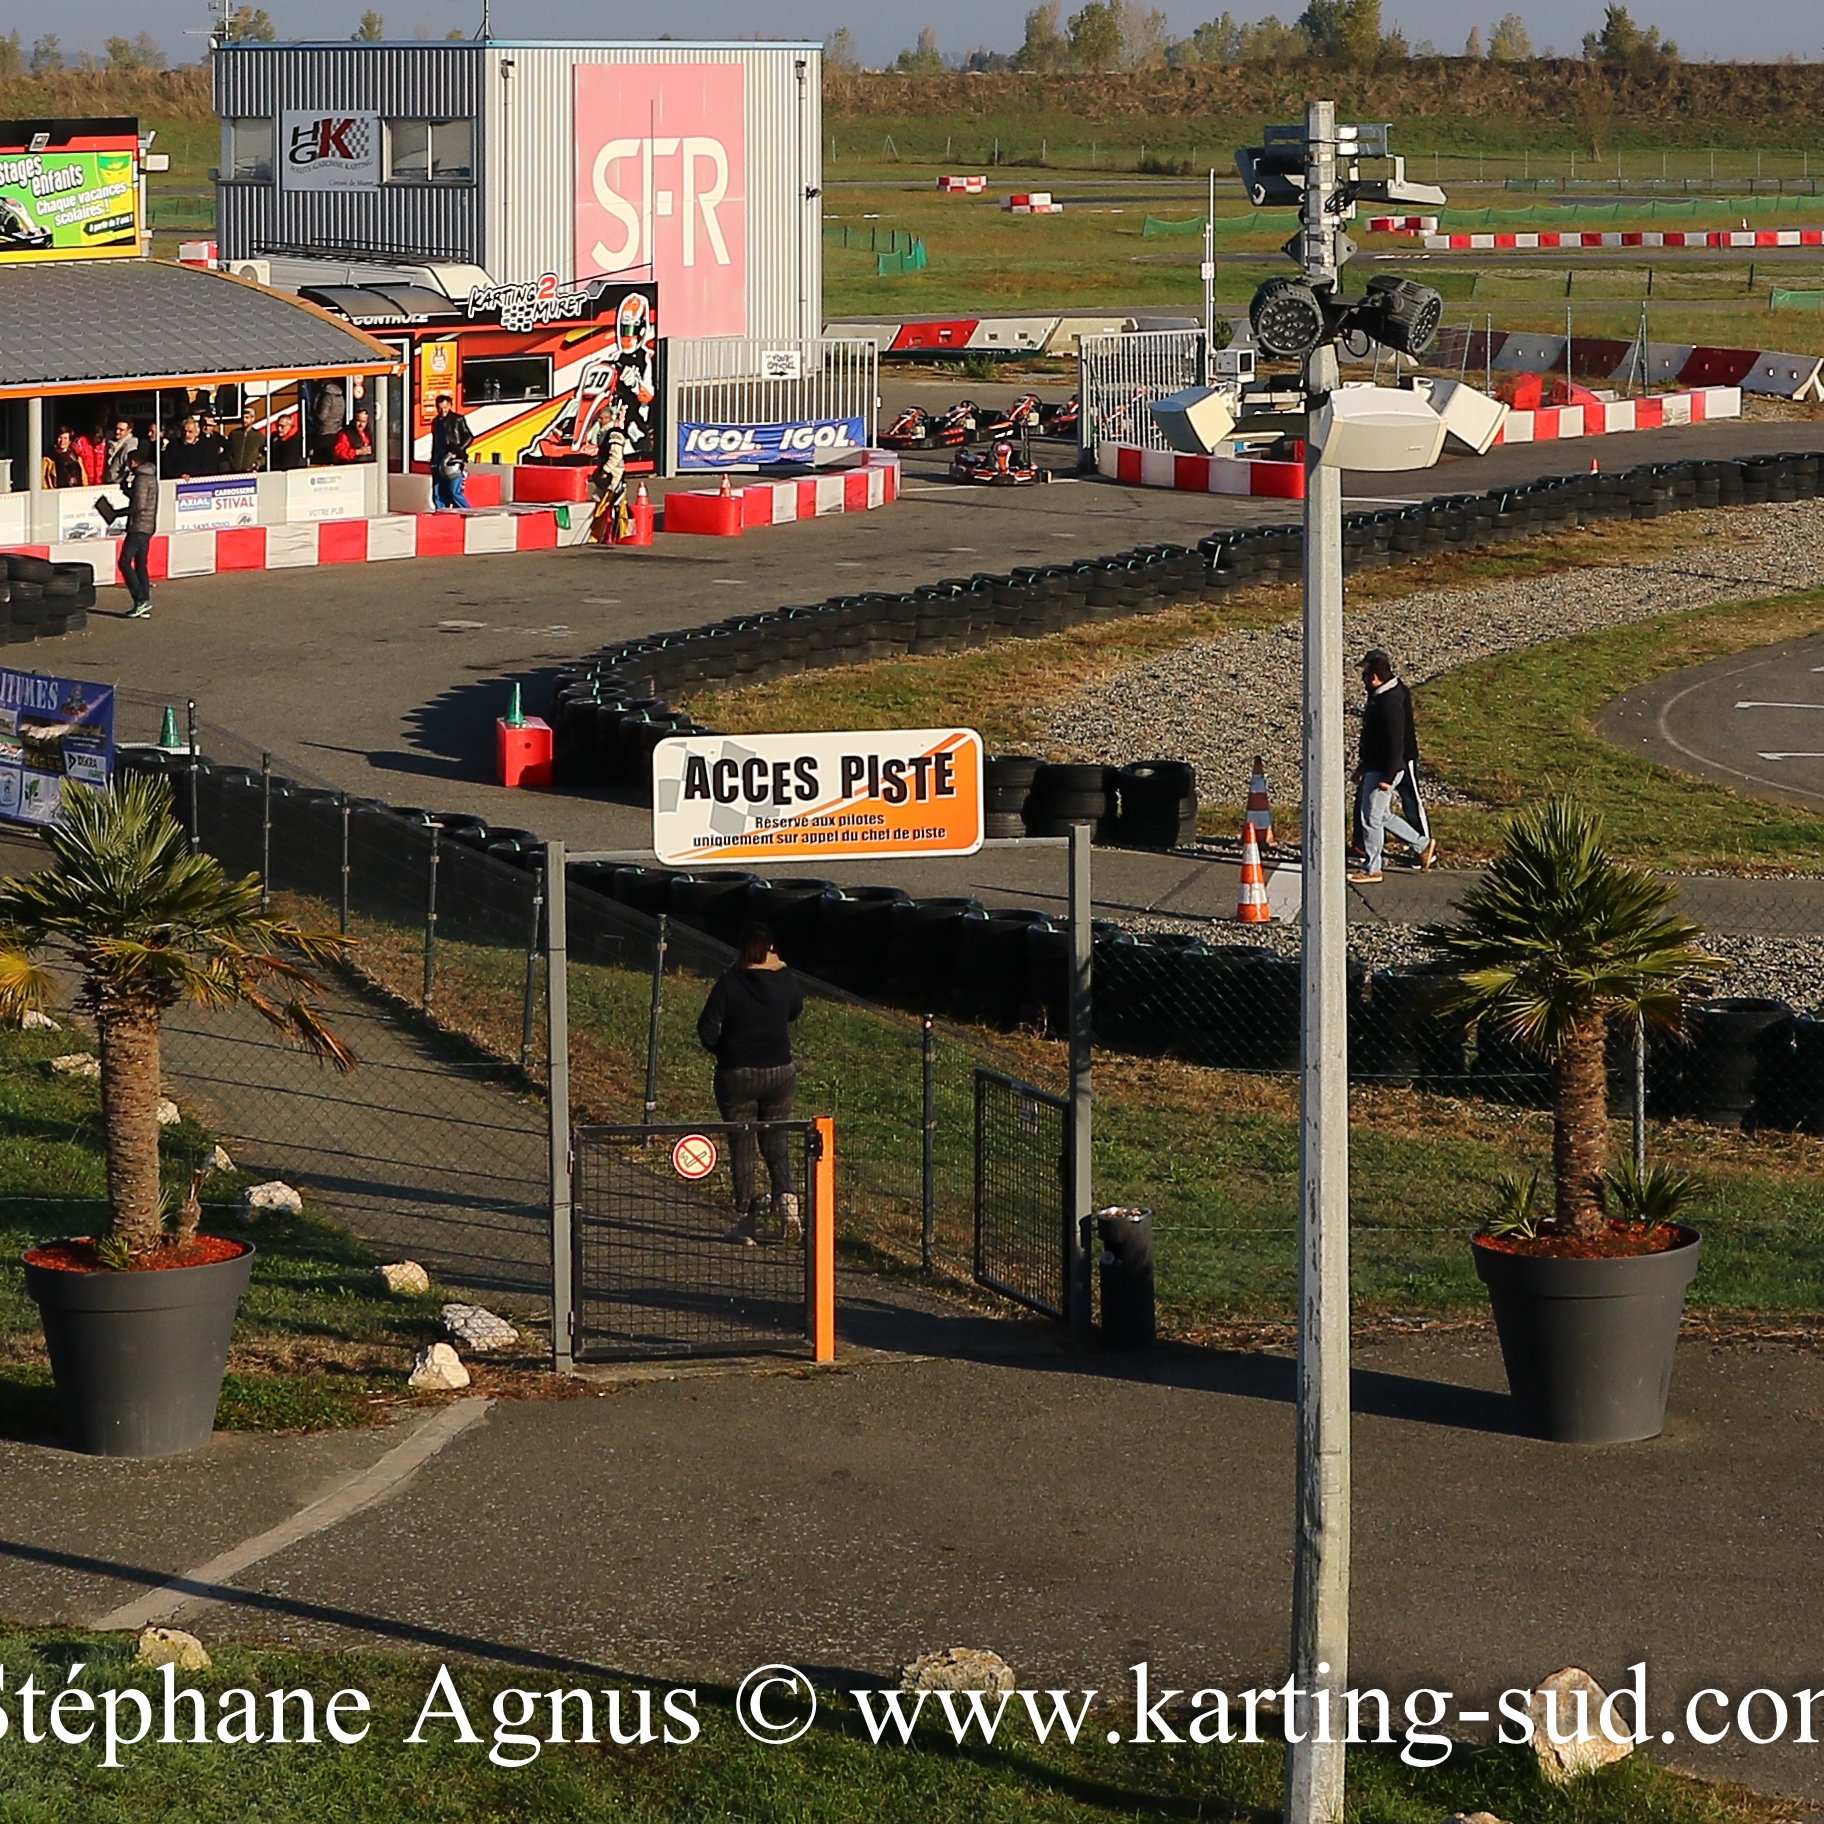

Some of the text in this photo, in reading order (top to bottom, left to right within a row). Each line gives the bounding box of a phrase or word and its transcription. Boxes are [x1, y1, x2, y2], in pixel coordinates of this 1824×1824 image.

[32, 165, 84, 197] enfants
[36, 182, 127, 215] Chaque vacances
[591, 136, 731, 272] SFR
[55, 202, 104, 227] scolaires
[469, 274, 558, 317] KARTING 2
[533, 296, 587, 322] MURET
[588, 369, 610, 389] 30
[179, 496, 254, 510] AXIAL STIVAL
[214, 486, 255, 497] CARROSSERIE
[308, 507, 344, 518] VOTRE PUB
[684, 753, 956, 805] ACCES PISTE
[755, 812, 885, 829] Réservé aux pilotes
[693, 826, 946, 848] uniquement sur appel du chef de piste
